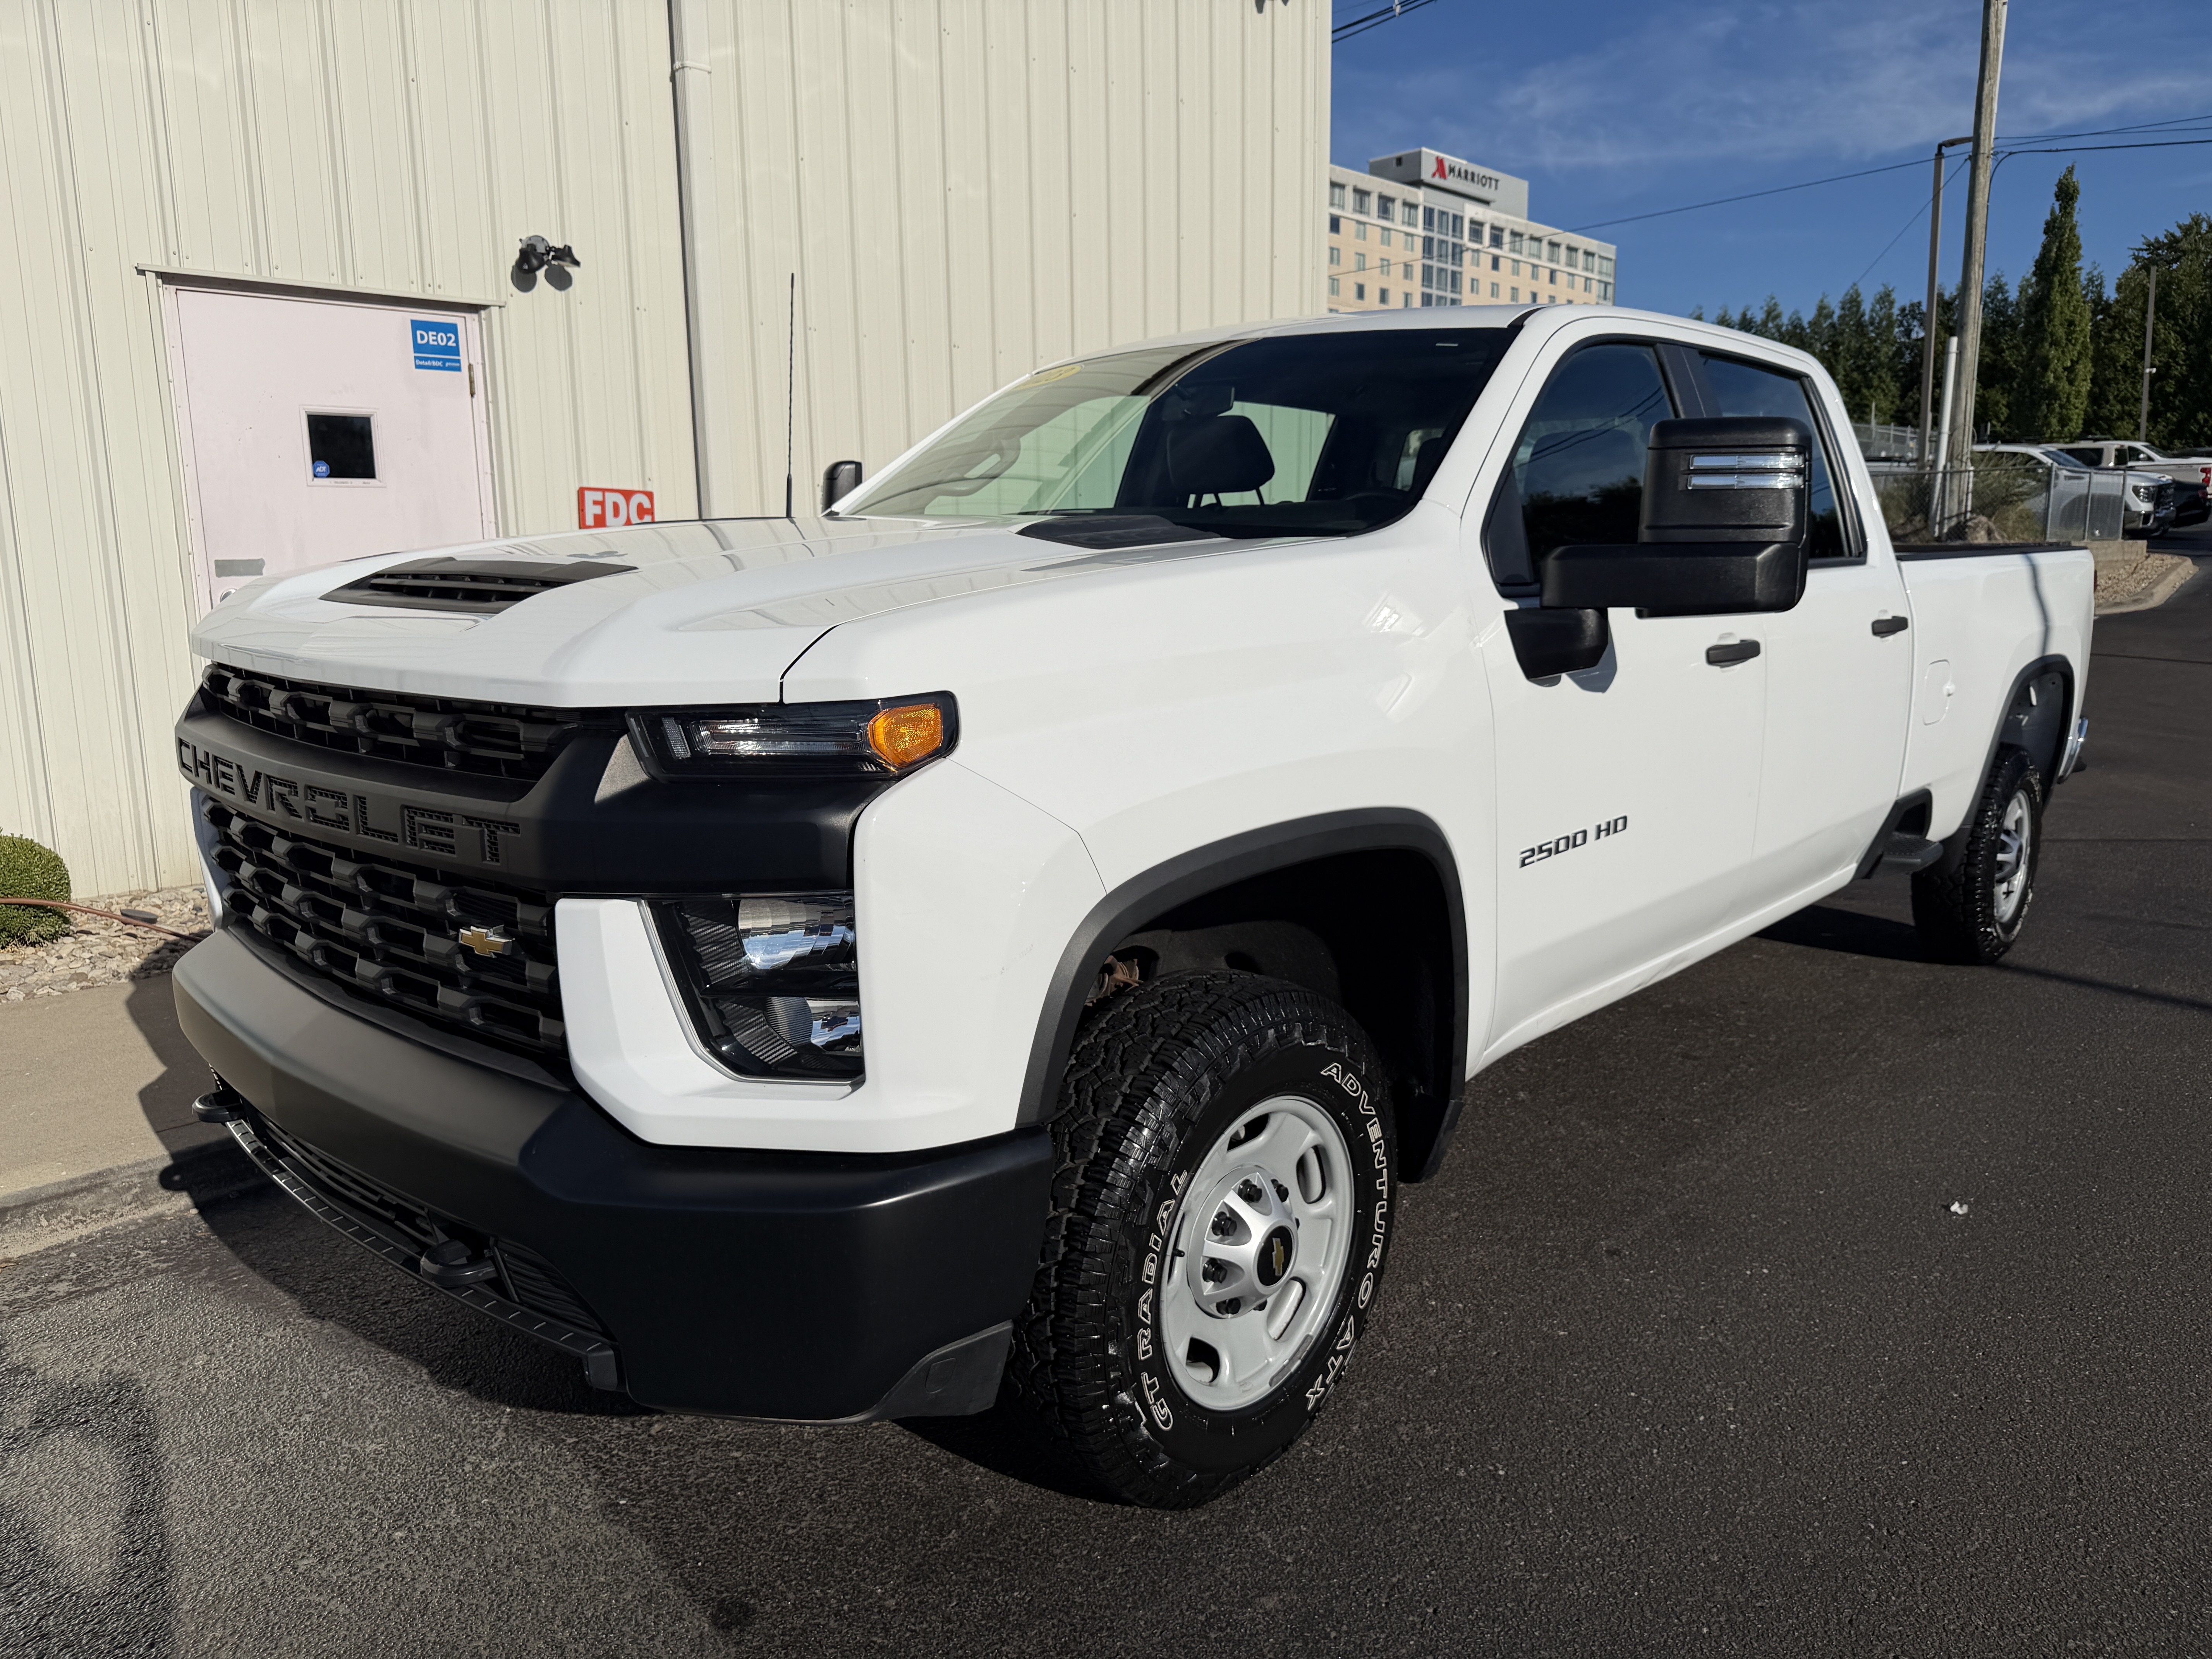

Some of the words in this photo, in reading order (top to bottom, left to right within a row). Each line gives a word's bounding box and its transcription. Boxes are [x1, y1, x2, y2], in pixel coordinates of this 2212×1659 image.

[1448, 164, 1499, 191] MARRIOTT
[416, 330, 456, 347] DE02
[584, 490, 652, 527] FDC
[178, 737, 520, 866] CHEVROLET
[1519, 827, 1587, 868] 2500
[1594, 813, 1628, 841] HD
[1320, 1062, 1388, 1310] ADVENTURO
[1138, 1169, 1188, 1361] RADIAL
[1305, 1314, 1355, 1412] ATX
[1140, 1371, 1173, 1431] GT
